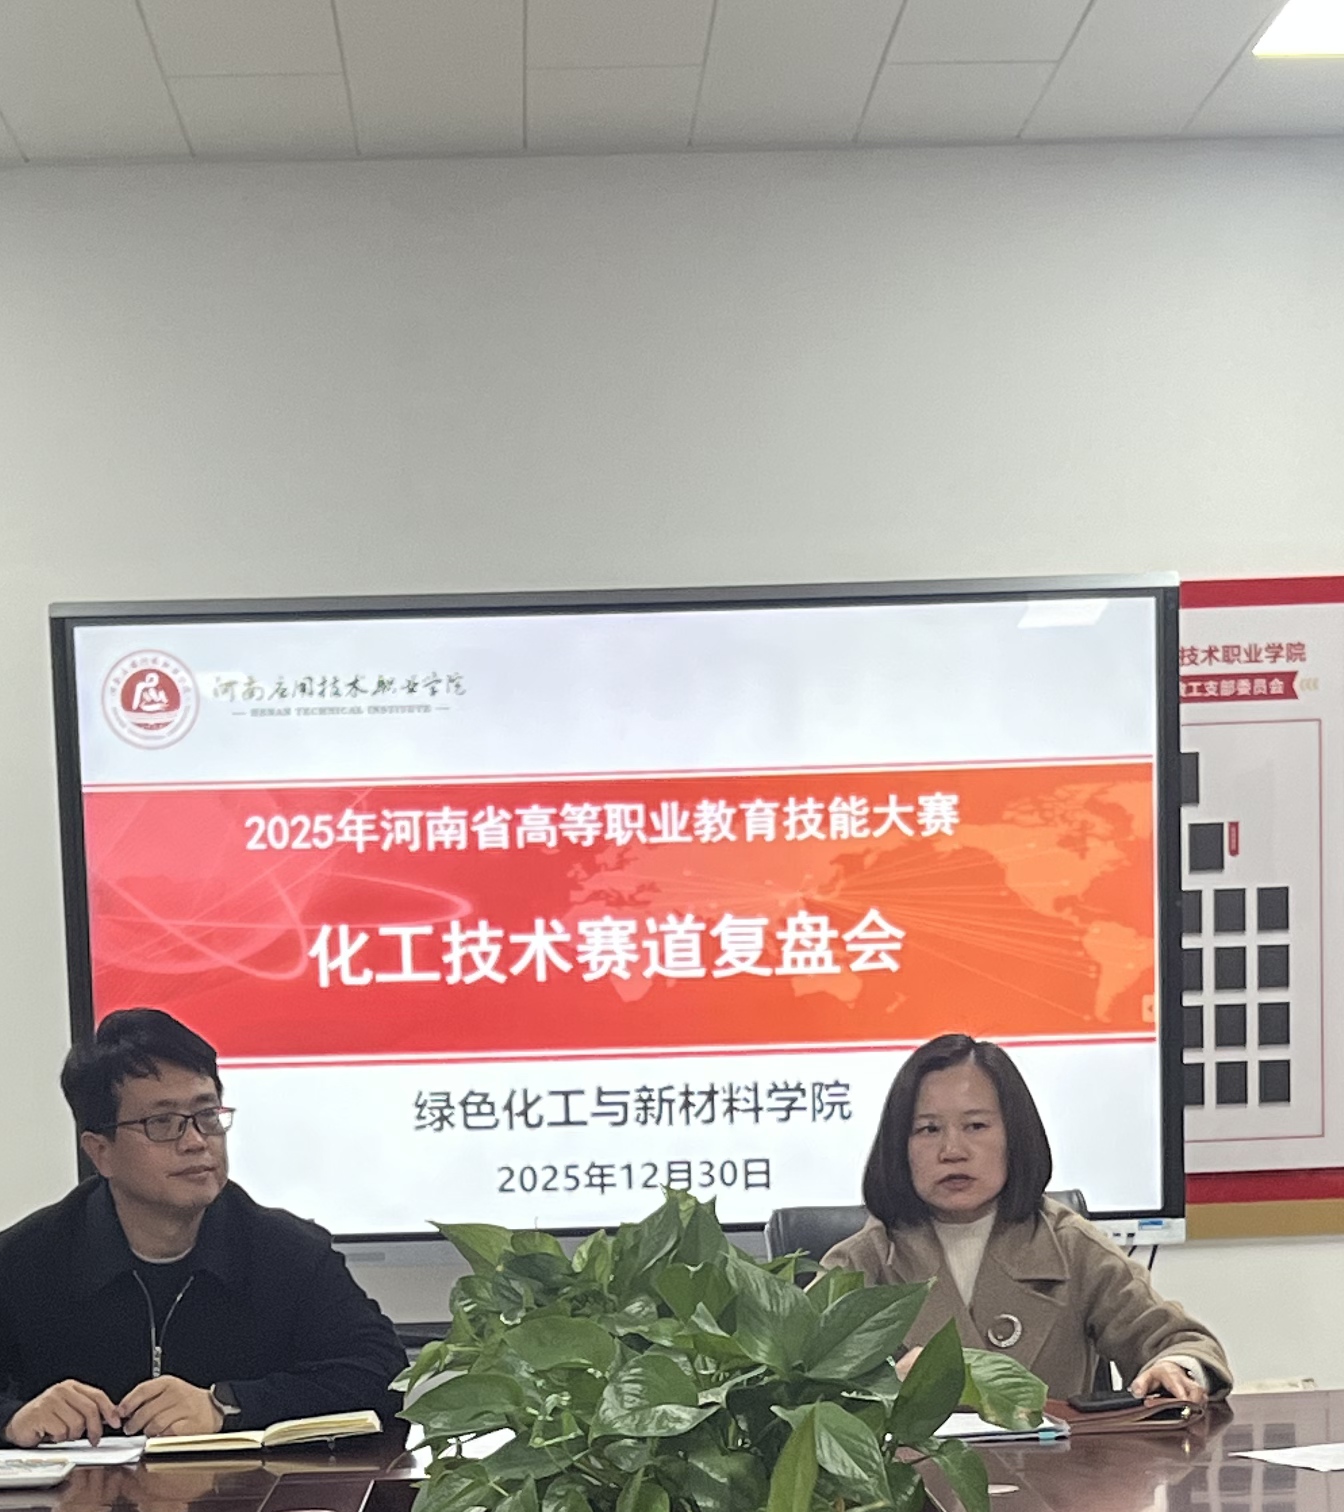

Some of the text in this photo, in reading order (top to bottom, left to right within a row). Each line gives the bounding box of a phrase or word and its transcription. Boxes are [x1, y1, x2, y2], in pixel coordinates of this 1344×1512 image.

[244, 790, 962, 855] 2025年河南省高等职业教育技能大赛
[306, 906, 908, 989] 化工技术赛道复盘会
[412, 1078, 853, 1133] 绿色化工与新材料学院
[497, 1157, 773, 1195] 2025年12月30日
